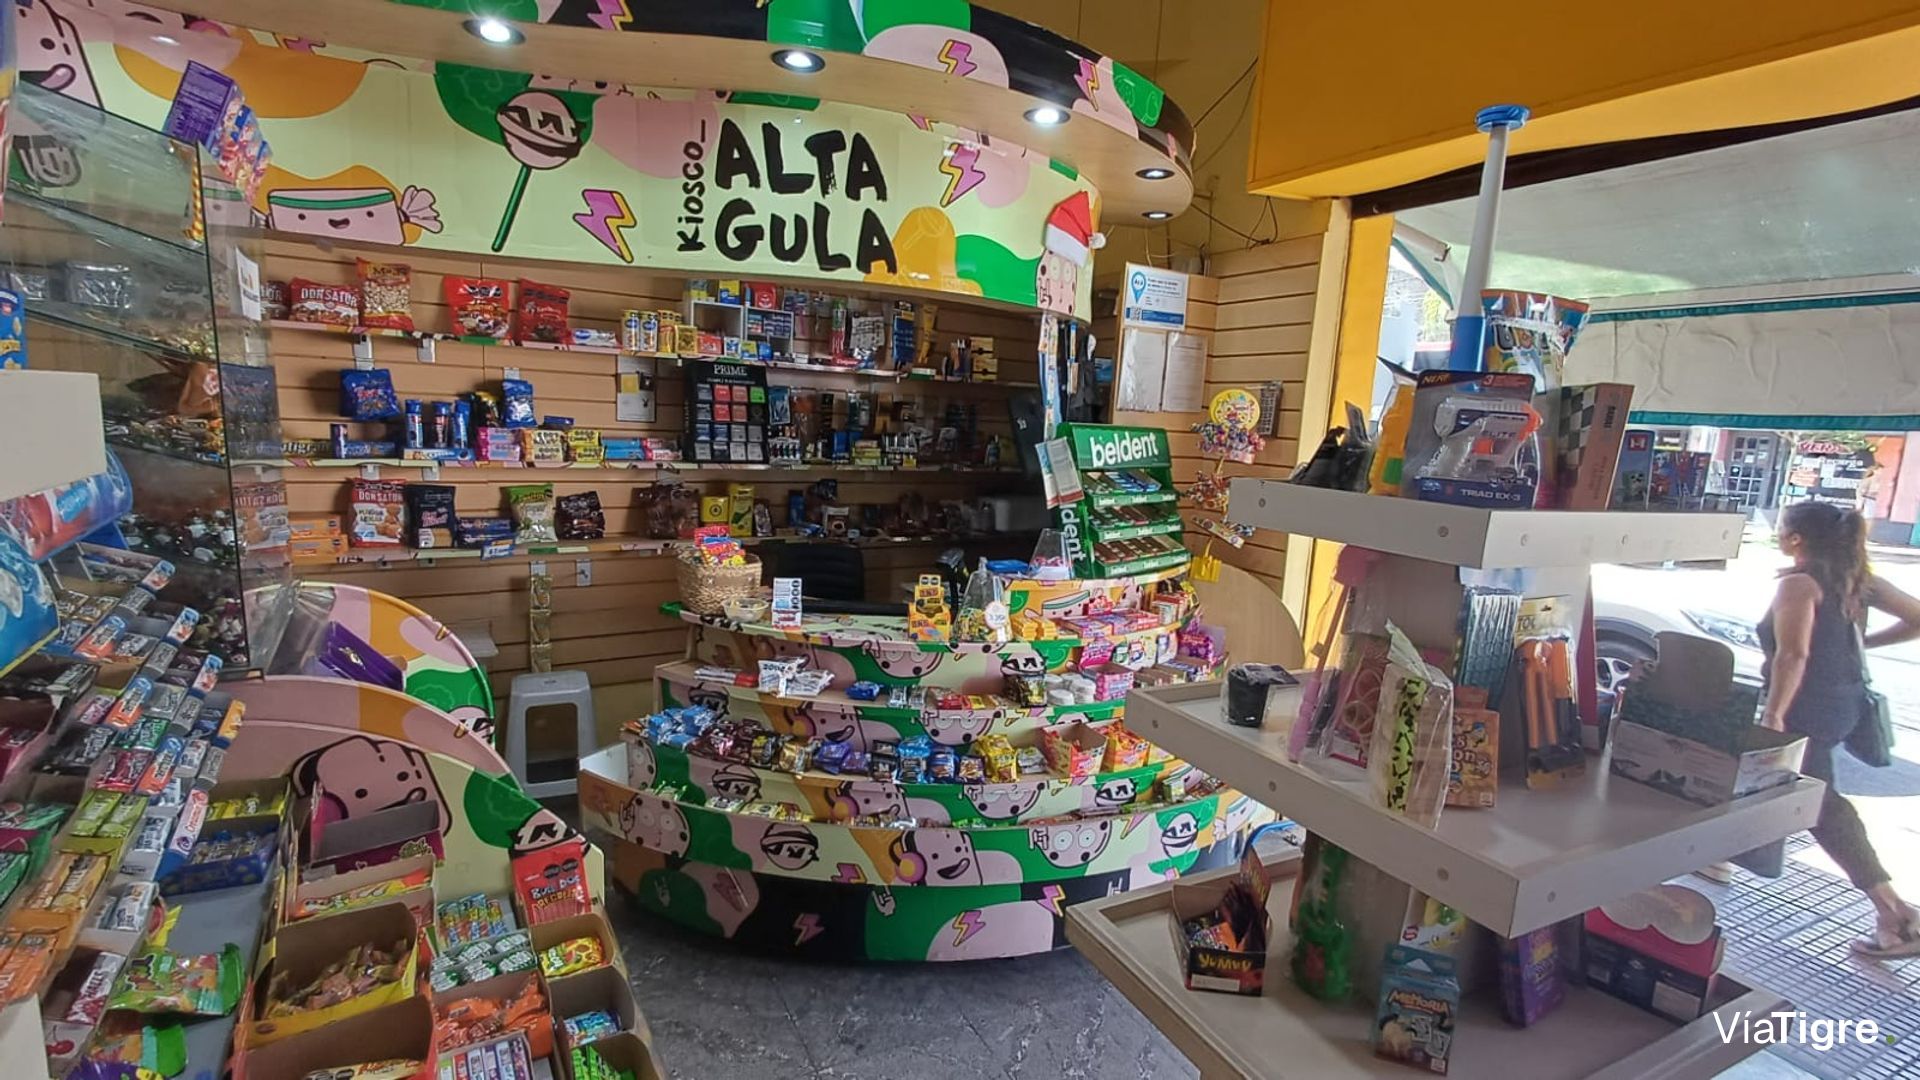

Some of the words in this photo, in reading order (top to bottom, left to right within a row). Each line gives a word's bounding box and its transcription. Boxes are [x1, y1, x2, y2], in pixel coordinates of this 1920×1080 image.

[715, 118, 887, 202] ALTA
[715, 197, 898, 275] GULA
[713, 364, 748, 376] PRIME
[1090, 432, 1159, 468] beldent
[1460, 488, 1495, 499] TRIAD
